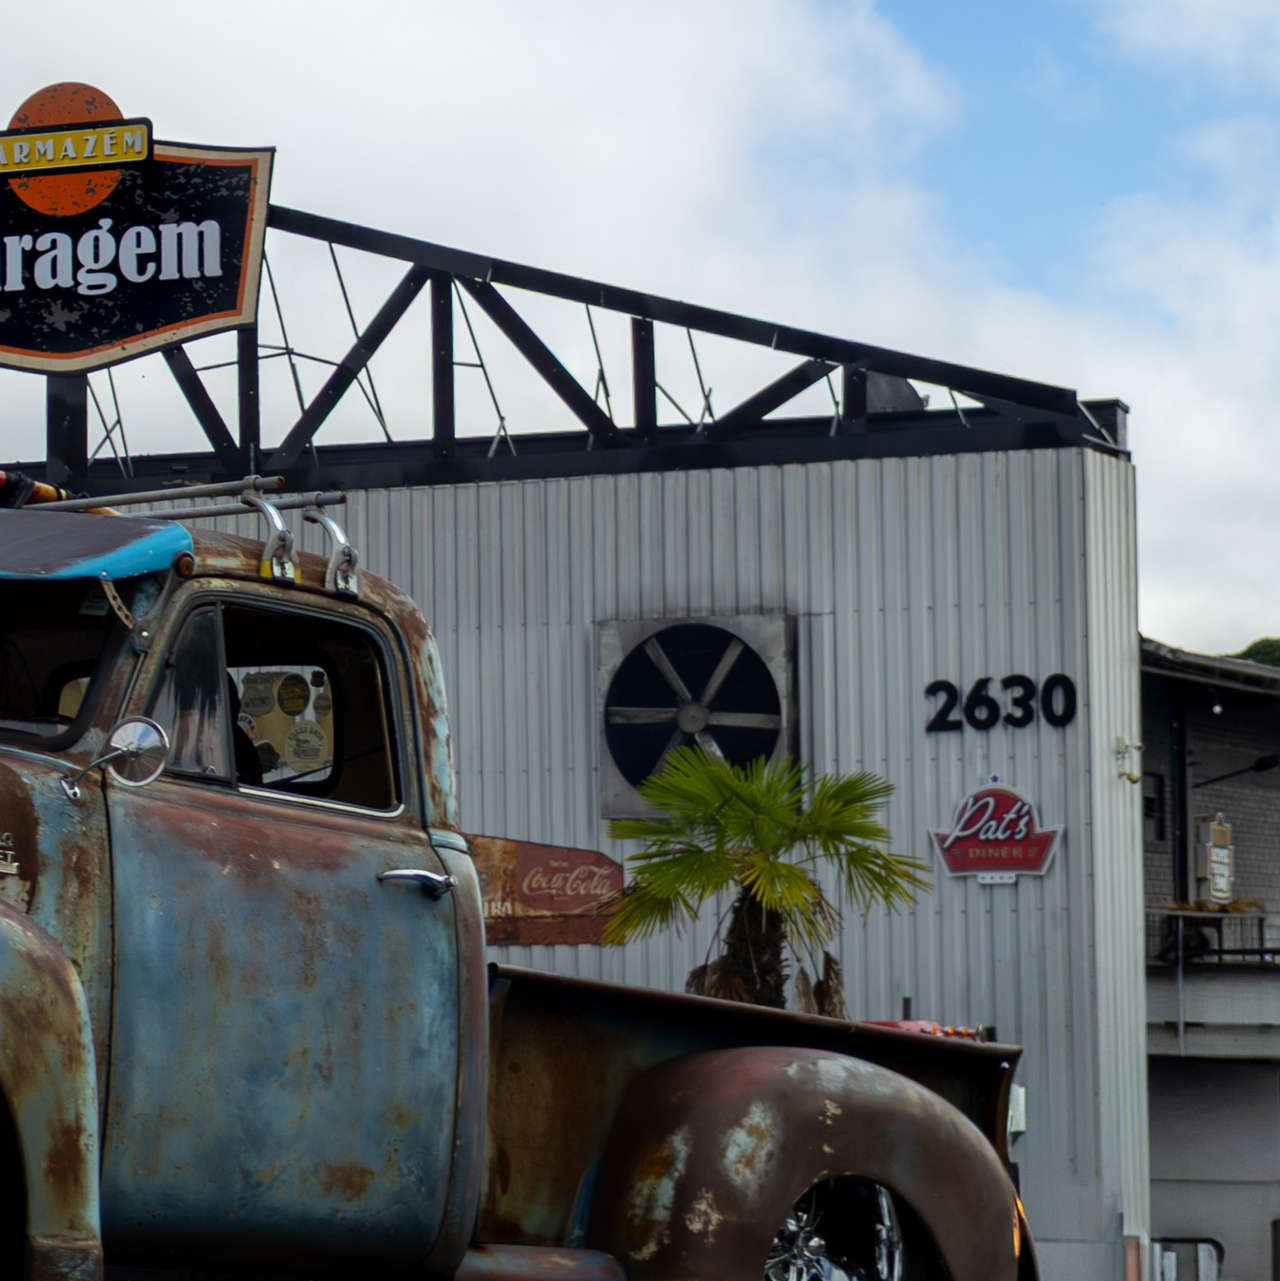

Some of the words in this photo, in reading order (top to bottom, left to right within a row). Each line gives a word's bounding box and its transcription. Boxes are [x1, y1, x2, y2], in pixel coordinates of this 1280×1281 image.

[924, 673, 1078, 733] 2630
[941, 795, 1031, 849] Pat's
[968, 846, 1024, 859] DINER
[521, 865, 616, 897] Coca-Cola
